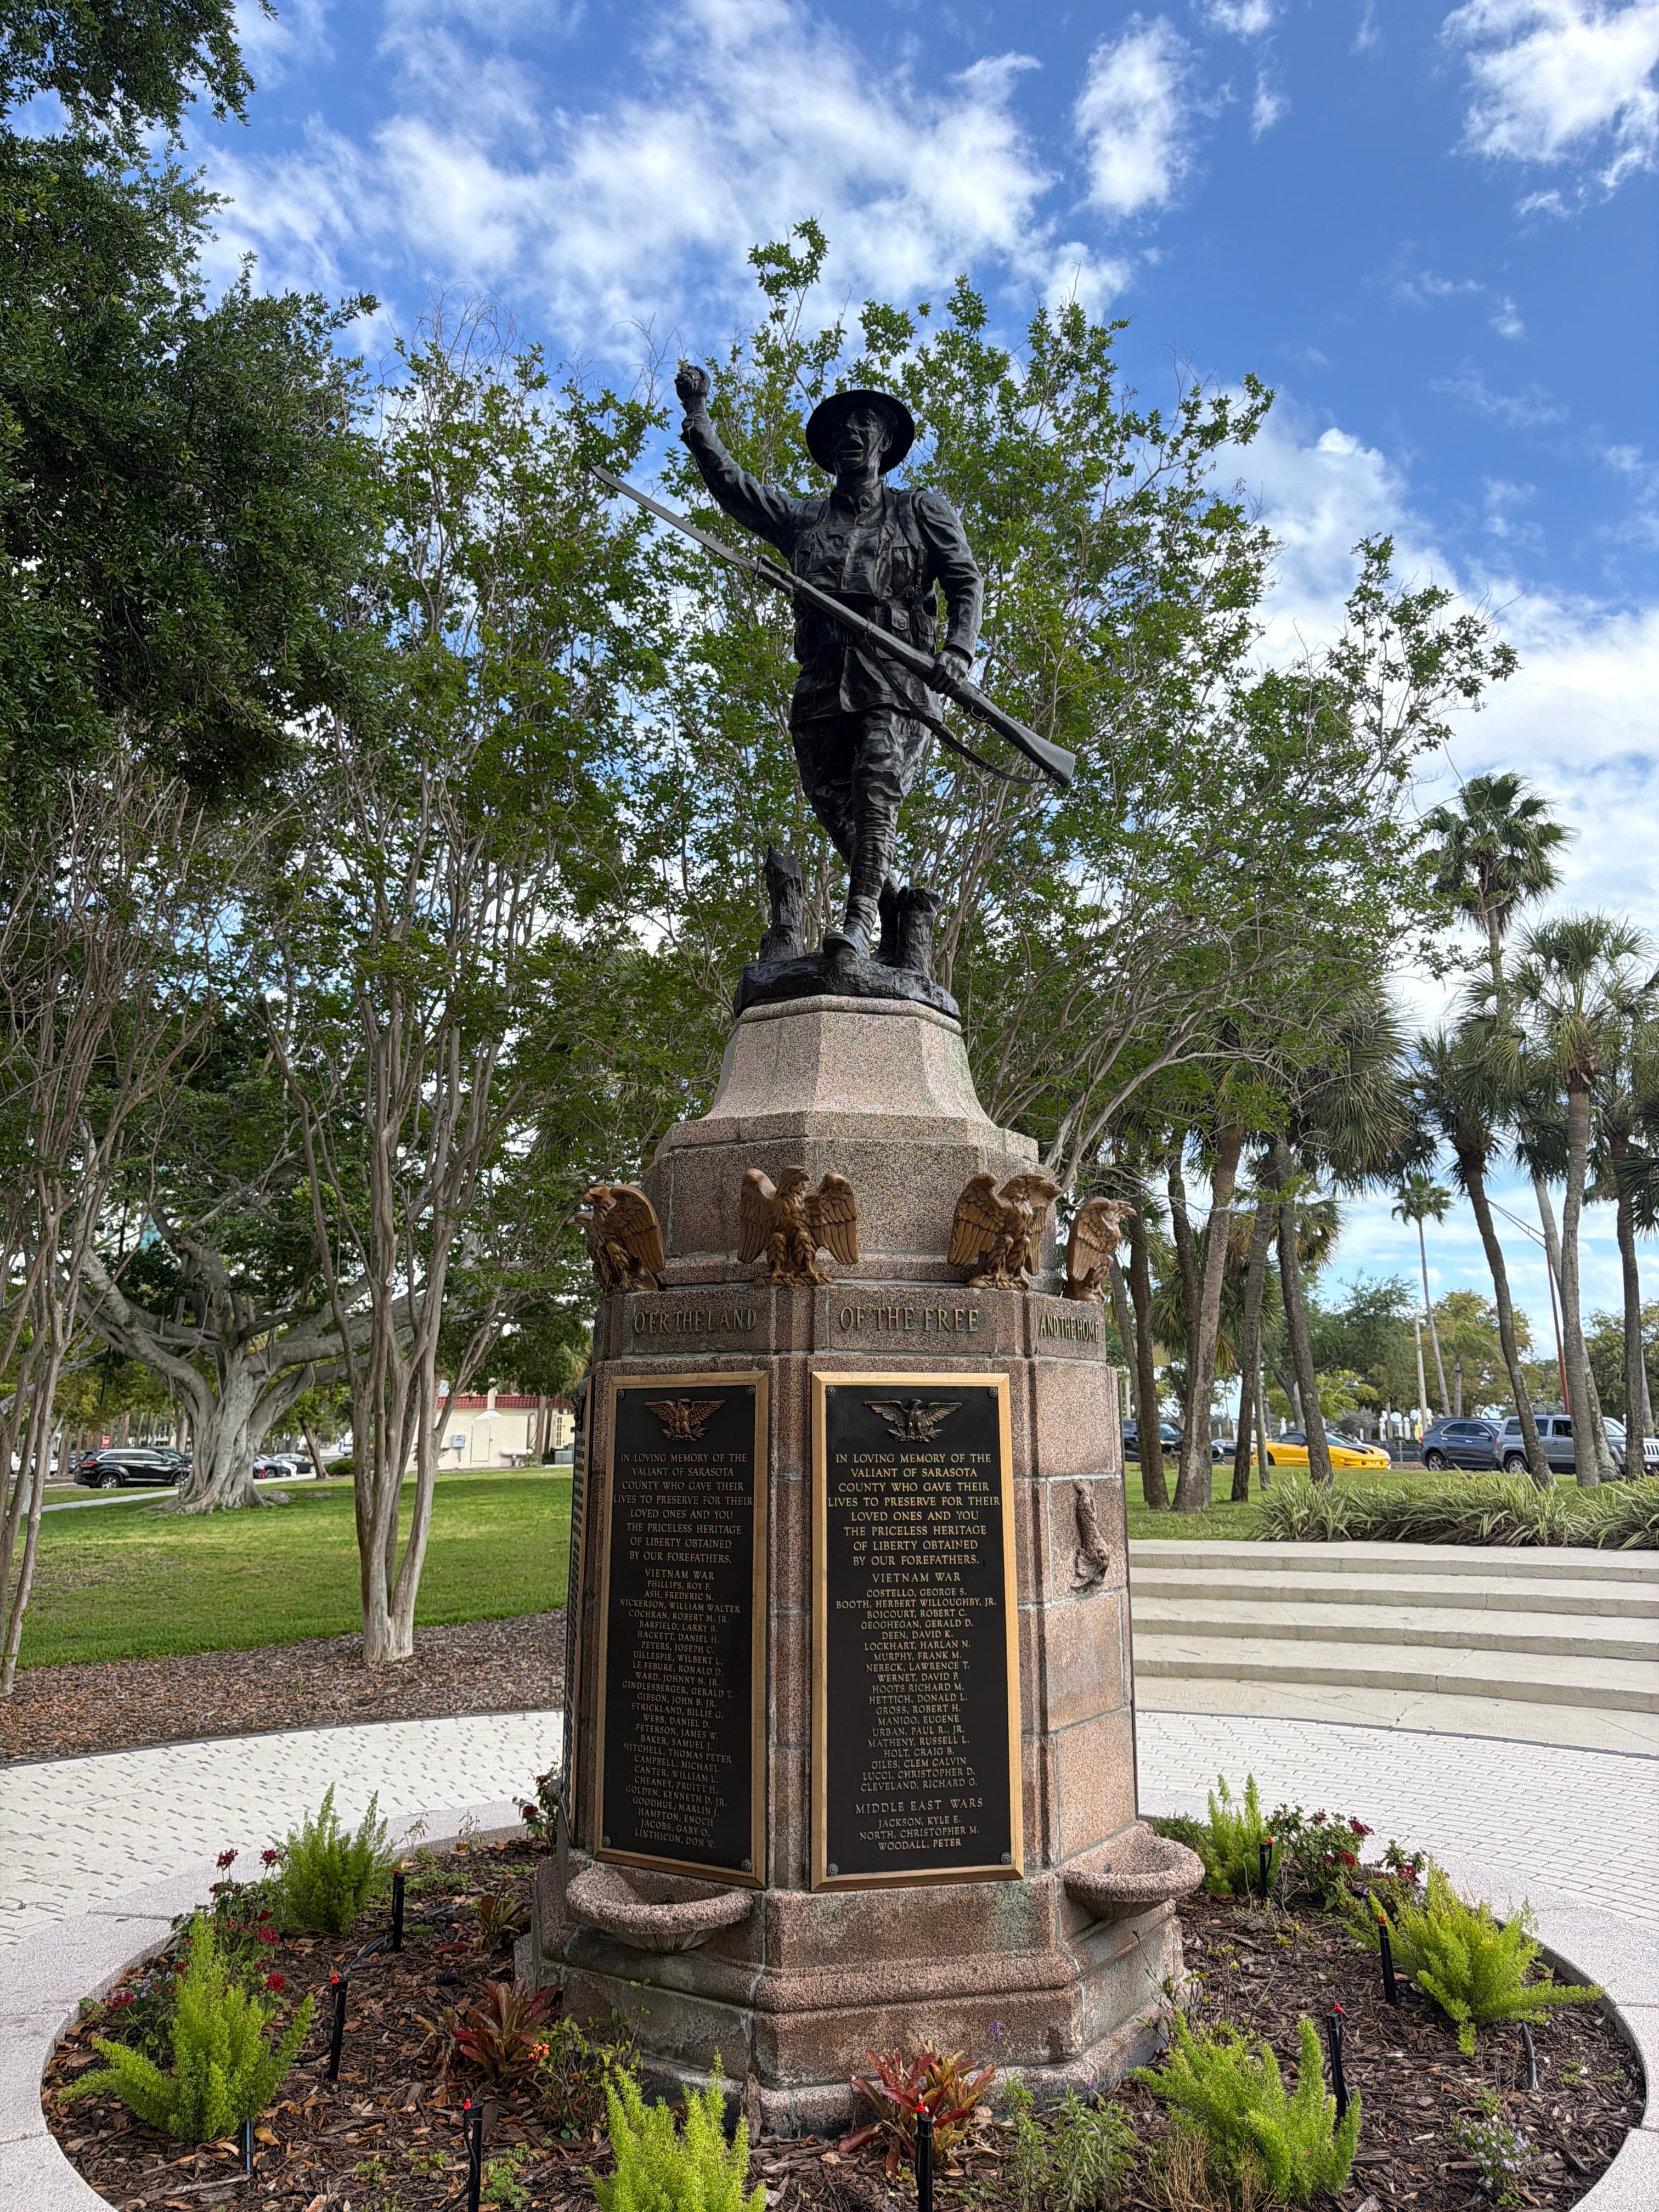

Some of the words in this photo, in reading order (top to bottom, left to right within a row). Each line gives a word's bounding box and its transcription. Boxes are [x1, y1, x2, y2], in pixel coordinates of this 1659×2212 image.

[634, 1312, 670, 1333] O'ER
[674, 1311, 703, 1332] THE
[708, 1308, 757, 1330] LAND
[840, 1307, 866, 1330] OF
[874, 1306, 914, 1330] THE
[924, 1308, 979, 1332] FREE
[1040, 1314, 1059, 1336] AND
[1059, 1317, 1075, 1339] THE
[1077, 1319, 1100, 1342] HOME
[635, 1453, 666, 1462] LOVING
[671, 1453, 708, 1462] MEMORY
[713, 1453, 725, 1462] OF
[729, 1453, 747, 1462] THE
[836, 1454, 847, 1463] IN
[854, 1454, 894, 1463] LOVING
[900, 1454, 945, 1463] MEMORY
[951, 1453, 964, 1463] OF
[970, 1453, 991, 1463] THE
[633, 1468, 669, 1476] VALIANT
[673, 1468, 684, 1476] OF
[688, 1468, 733, 1476] SARASOTA
[851, 1468, 898, 1477] VALIANT
[904, 1468, 916, 1477] OF
[922, 1468, 977, 1477] SARASOTA
[623, 1481, 658, 1489] COUNTY
[663, 1481, 685, 1490] WHO
[689, 1481, 712, 1490] GAVE
[716, 1482, 744, 1491] THEIR
[839, 1482, 885, 1492] COUNTY
[891, 1482, 917, 1491] WHO
[923, 1482, 951, 1491] GAVE
[957, 1482, 989, 1491] THEIR
[614, 1495, 636, 1504] LIVES
[640, 1495, 652, 1503] TO
[657, 1496, 698, 1504] PRESERVE
[703, 1496, 720, 1504] FOR
[725, 1497, 754, 1506] THEIR
[828, 1497, 857, 1507] LIVES
[863, 1497, 878, 1506] TO
[885, 1497, 935, 1506] PRESERVE
[942, 1496, 963, 1505] FOR
[968, 1496, 1001, 1506] THEIR
[631, 1509, 658, 1517] LOVED
[663, 1509, 686, 1518] ONES
[690, 1510, 710, 1519] AND
[714, 1510, 733, 1519] YOU
[851, 1511, 887, 1521] LOVED
[894, 1511, 922, 1520] ONES
[928, 1511, 950, 1520] AND
[956, 1510, 978, 1520] YOU
[627, 1522, 643, 1531] THE
[648, 1523, 692, 1532] PRICELESS
[697, 1525, 742, 1534] HERITAGE
[844, 1526, 865, 1536] THE
[872, 1526, 927, 1536] PRICELESS
[933, 1525, 986, 1534] HERITAGE
[630, 1537, 642, 1545] OF
[646, 1537, 681, 1547] LIBERTY
[685, 1539, 732, 1548] OBTAINED
[854, 1541, 867, 1550] OF
[873, 1541, 917, 1550] LIBERTY
[923, 1540, 978, 1549] OBTAINED
[630, 1551, 639, 1559] BY
[644, 1551, 663, 1560] OUR
[668, 1553, 731, 1563] FOREFATHERS.
[853, 1556, 865, 1565] BY
[871, 1556, 895, 1565] OUR
[901, 1555, 979, 1565] FOREFATHERS.
[645, 1569, 688, 1578] VIETNAM
[693, 1571, 714, 1579] WAR
[872, 1573, 928, 1582] VIETNAM
[935, 1572, 961, 1581] WAR
[867, 1589, 916, 1597] COSTELLO,
[920, 1588, 956, 1596] GEORGE
[960, 1587, 967, 1595] S.
[620, 1599, 666, 1609] NICKERSON,
[669, 1602, 703, 1610] WILLIAM
[707, 1604, 740, 1613] WALTER
[837, 1600, 871, 1609] BOOTH,
[876, 1599, 916, 1607] HERBERT
[920, 1598, 981, 1606] WILLOUGHBY,
[985, 1597, 996, 1606] JR.
[867, 1610, 916, 1618] BOICOURT,
[920, 1609, 955, 1617] ROBERT
[958, 1608, 967, 1616] C.
[861, 1621, 921, 1629] GEOGHEGAN,
[926, 1619, 961, 1627] GERALD
[882, 1631, 908, 1639] DEEN,
[912, 1630, 941, 1639] DAVID
[865, 1641, 916, 1650] LOCKHART,
[921, 1640, 958, 1649] HARLAN
[874, 1652, 913, 1661] MURPHY,
[918, 1651, 948, 1660] FRANK
[910, 1661, 959, 1671] LAWRENCE
[962, 1661, 969, 1669] T.
[909, 1683, 950, 1691] RICHARD
[869, 1695, 913, 1704] HETTICH,
[917, 1693, 956, 1702] DONALD
[960, 1692, 967, 1701] L.
[876, 1706, 909, 1714] GROSS,
[913, 1704, 948, 1713] ROBERT
[952, 1703, 961, 1712] H.
[923, 1714, 959, 1723] EUGENE
[873, 1728, 907, 1736] URBAN,
[911, 1726, 934, 1735] PAUL
[953, 1725, 964, 1735] JR.
[868, 1738, 915, 1747] MATHENY,
[919, 1736, 958, 1745] RUSSELL
[962, 1735, 969, 1743] L.
[624, 1743, 665, 1755] MITCHELL,
[668, 1748, 703, 1759] THOMAS
[707, 1753, 731, 1763] PETER
[884, 1748, 910, 1757] HOLT,
[914, 1747, 943, 1756] CRAIG
[635, 1755, 678, 1767] CAMPBELL,
[681, 1761, 719, 1772] MICHAEL
[872, 1760, 900, 1769] GILES,
[904, 1759, 928, 1768] CLEM
[932, 1757, 966, 1766] CALVIN
[898, 1768, 963, 1778] CHRISTOPHER
[967, 1767, 975, 1775] D.
[861, 1781, 918, 1791] CLEVELAND,
[923, 1779, 965, 1788] RICHARD
[856, 1802, 904, 1813] MIDDLE
[911, 1799, 941, 1810] EAST
[950, 1798, 982, 1808] WARS
[639, 1808, 681, 1821] HAMPTON,
[685, 1815, 713, 1826] ENOCH
[878, 1818, 923, 1829] JACKSON,
[928, 1815, 949, 1825] KYLE
[953, 1815, 961, 1823] E.
[860, 1830, 896, 1839] NORTH,
[900, 1826, 966, 1837] CHRISTOPHER
[969, 1826, 979, 1834] M.
[878, 1841, 929, 1850] WOODALL,
[933, 1838, 961, 1847] PETER
